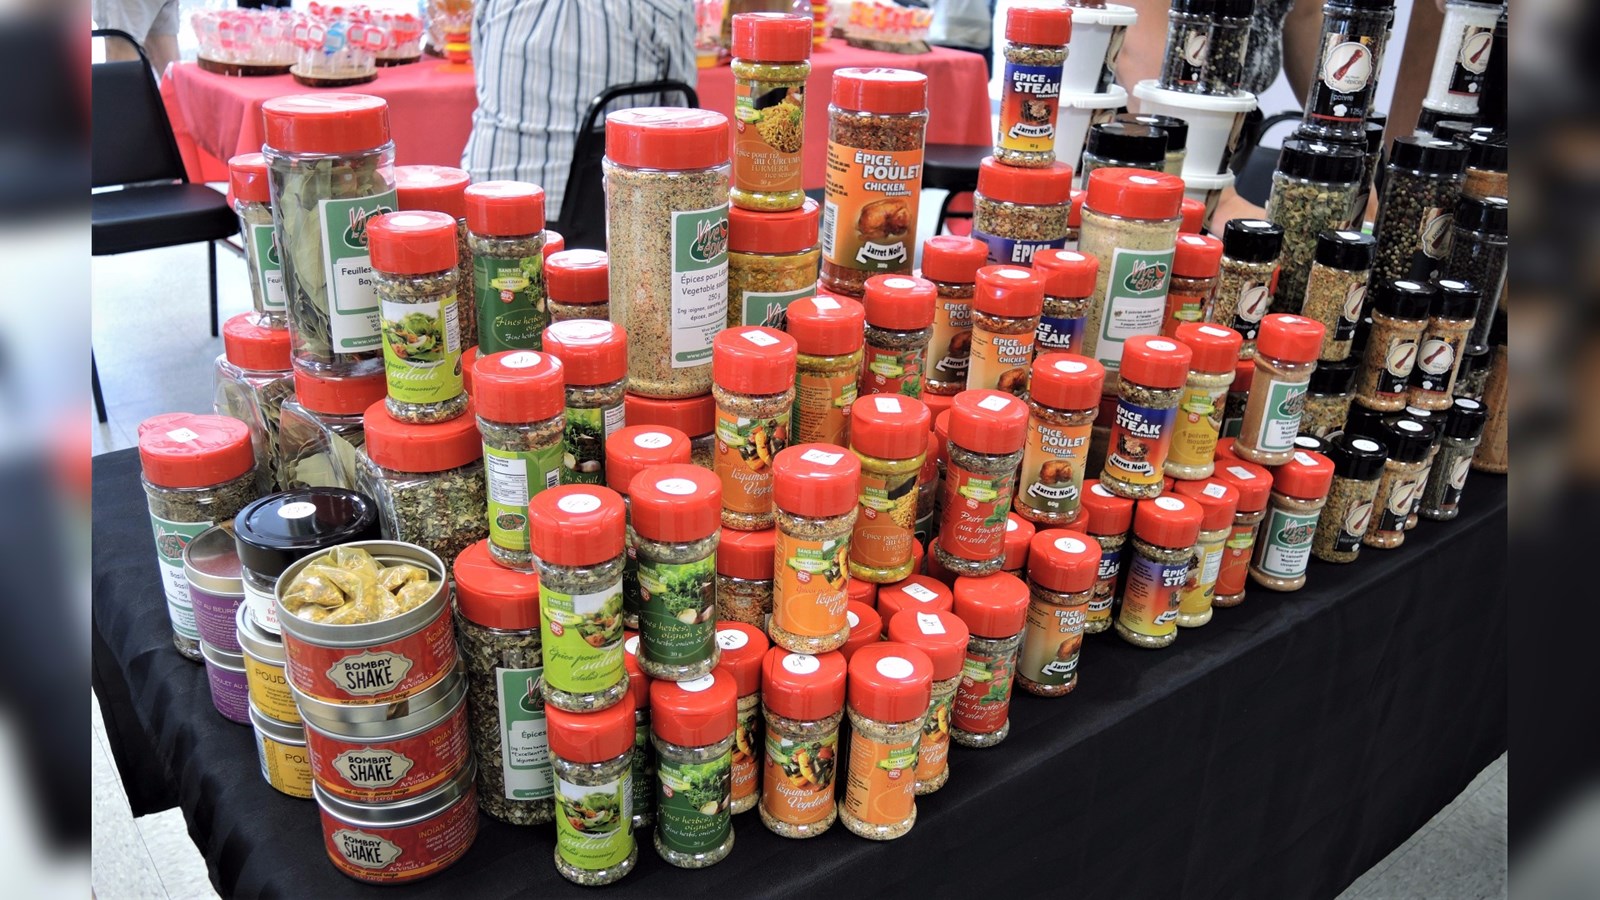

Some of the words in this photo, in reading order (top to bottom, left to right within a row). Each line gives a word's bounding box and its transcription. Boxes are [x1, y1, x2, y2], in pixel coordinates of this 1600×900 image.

[1013, 71, 1046, 82] ÉPICE
[1014, 82, 1059, 94] STEAK
[1018, 125, 1037, 135] Jarret
[855, 151, 892, 166] ÉPICE
[864, 164, 920, 180] POULET
[864, 182, 906, 192] CHICKEN
[867, 244, 886, 256] Jarret
[888, 245, 901, 256] Noir
[342, 267, 371, 276] Feuilles
[359, 278, 372, 287] Bay
[681, 273, 704, 285] Épices
[706, 272, 718, 280] pour
[682, 284, 715, 296] Vegetable
[950, 310, 970, 320] POU
[993, 338, 1018, 346] ÉPICE
[1117, 404, 1142, 421] ÉPICE
[1116, 414, 1161, 434] STEAK
[1042, 435, 1086, 447] POULET
[1042, 446, 1072, 454] CHICKEN
[1113, 456, 1130, 469] Jarret
[731, 468, 768, 483] légumes
[1036, 485, 1057, 496] Jarret
[1058, 487, 1074, 496] Noir
[1164, 575, 1187, 586] STE
[662, 633, 692, 641] oignon
[345, 657, 392, 670] BOMBAY
[256, 668, 286, 684] POUD
[346, 666, 393, 689] SHAKE
[522, 731, 546, 739] Épices
[350, 764, 393, 782] SHAKE
[400, 771, 434, 788] Arvinda's
[776, 782, 813, 797] légumes
[419, 824, 445, 839] INDIAN
[343, 834, 381, 847] BOMBAY
[344, 842, 382, 863] SHAKE
[389, 862, 425, 872] Arvinda's
